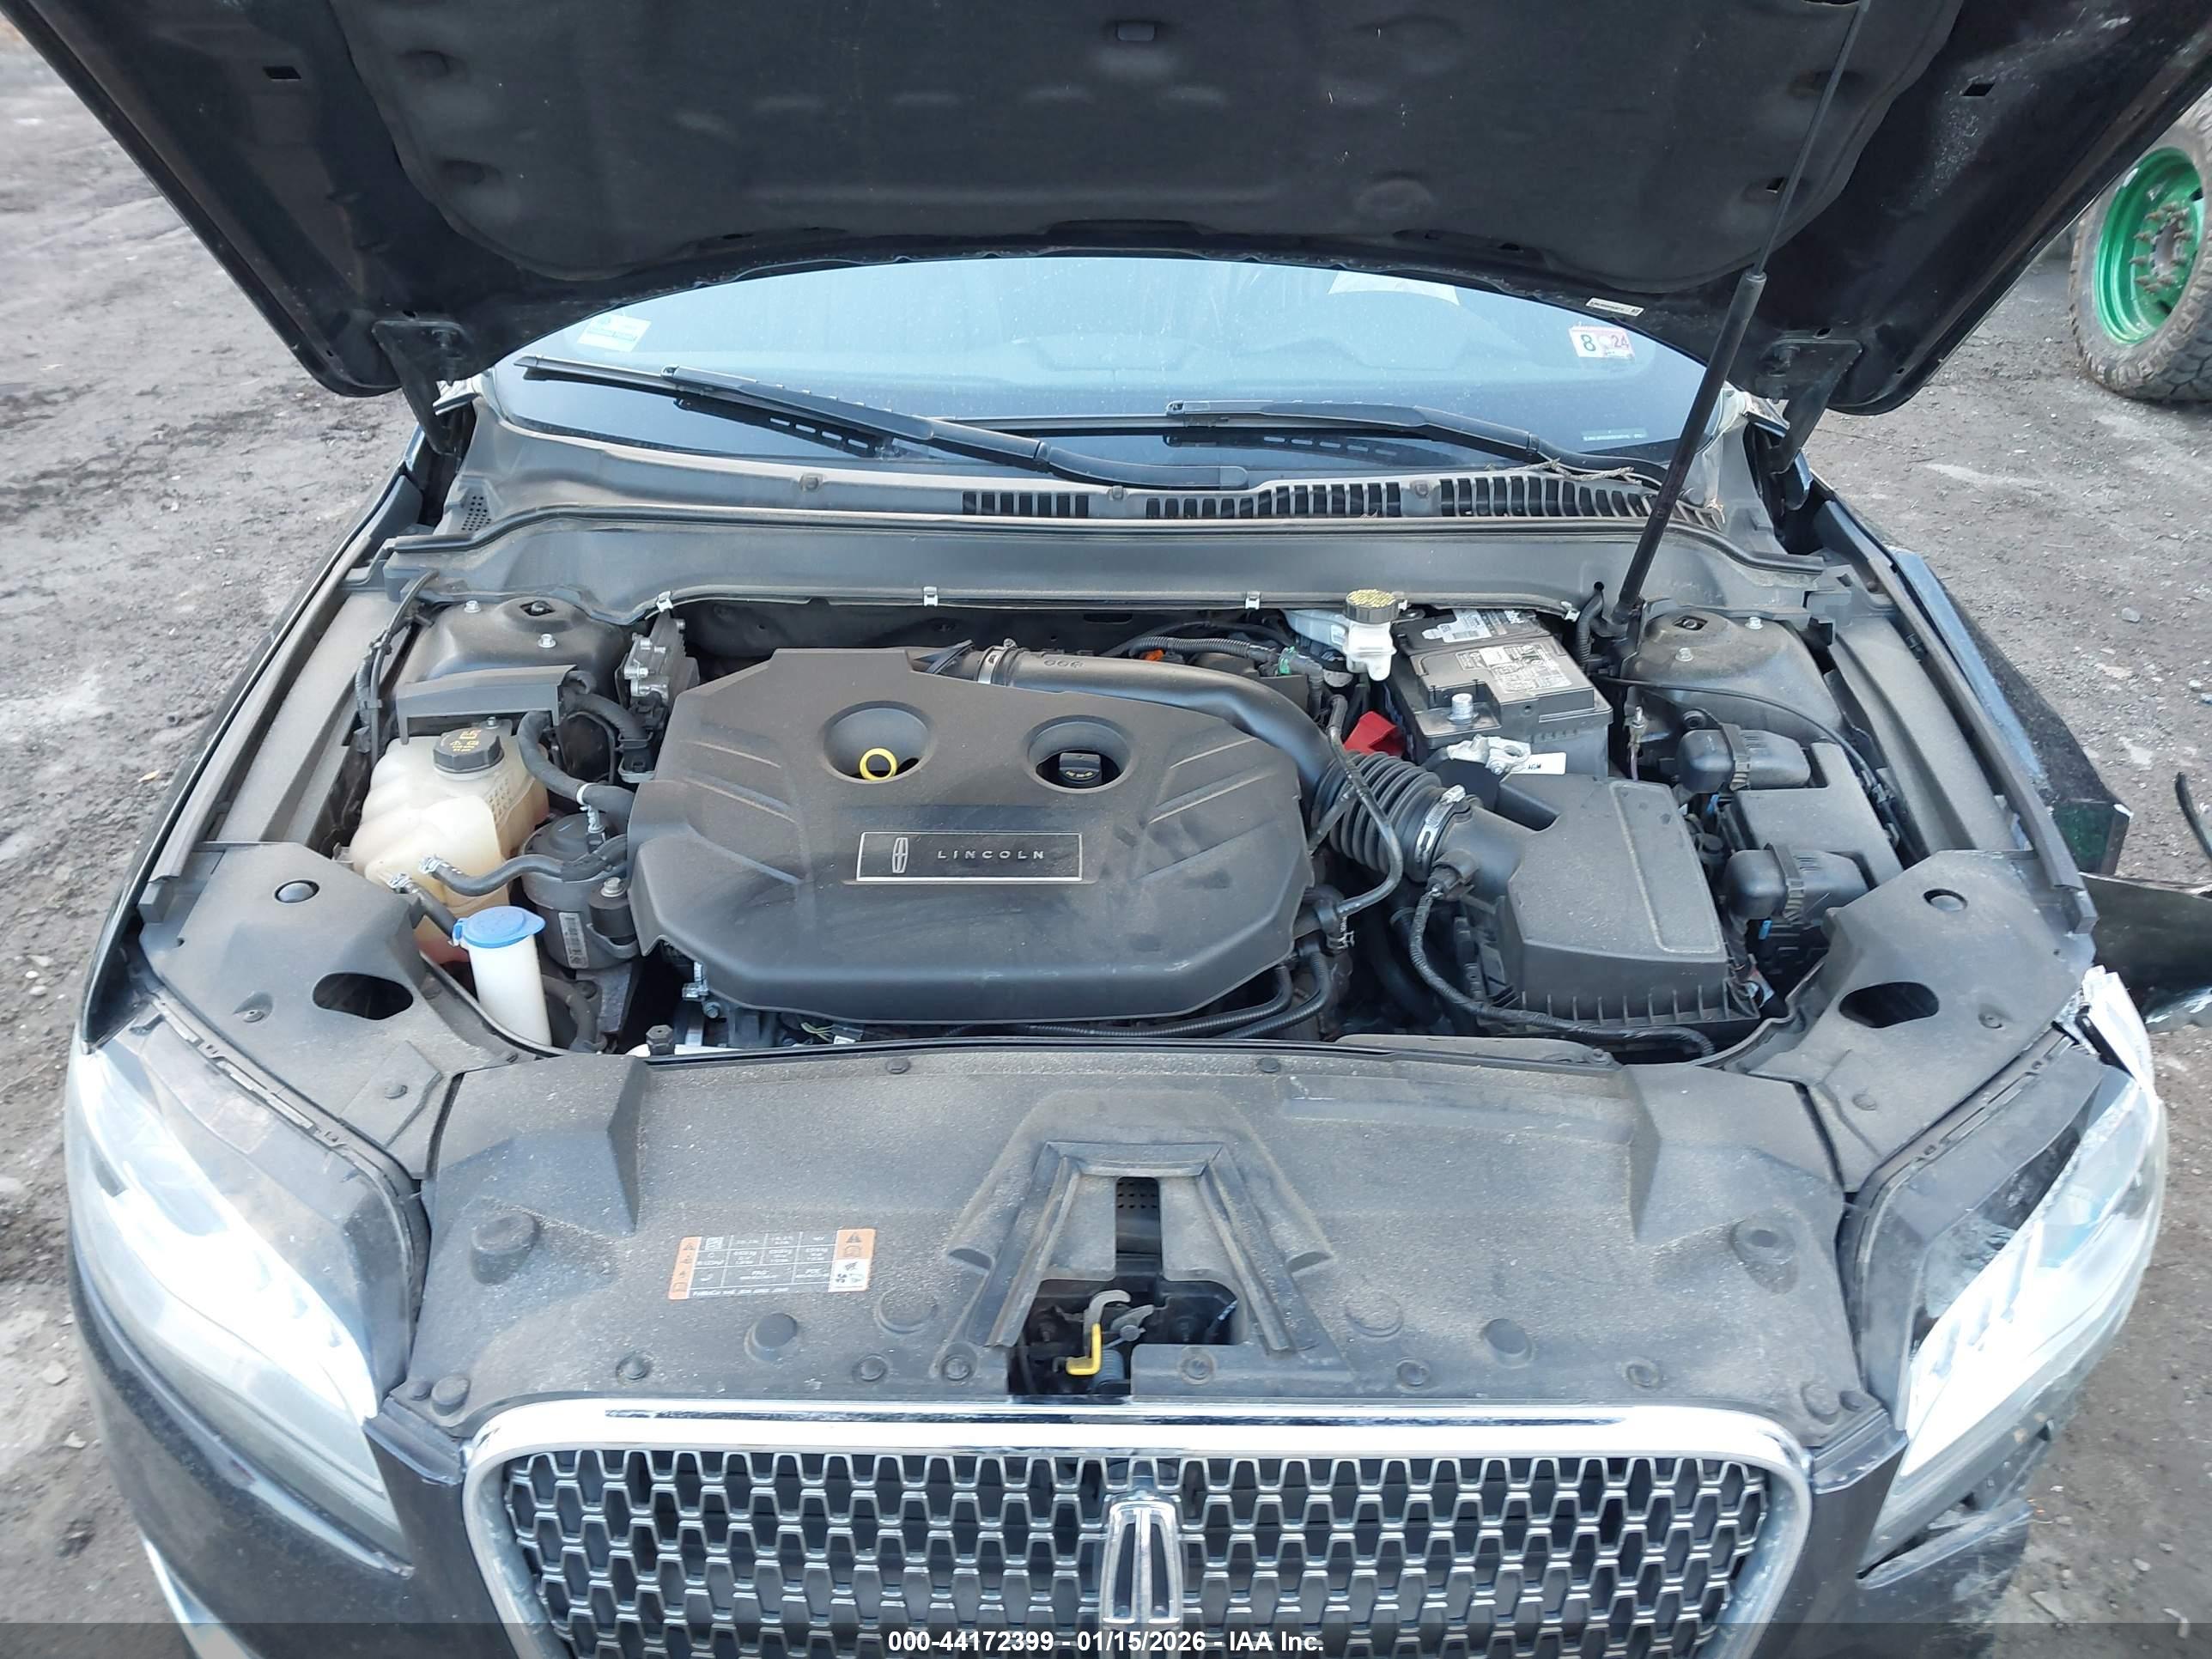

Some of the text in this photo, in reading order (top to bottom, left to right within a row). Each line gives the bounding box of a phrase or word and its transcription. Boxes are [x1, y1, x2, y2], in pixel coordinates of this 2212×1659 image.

[1580, 334, 1629, 351] 8 24
[937, 849, 1046, 860] LINCOLN
